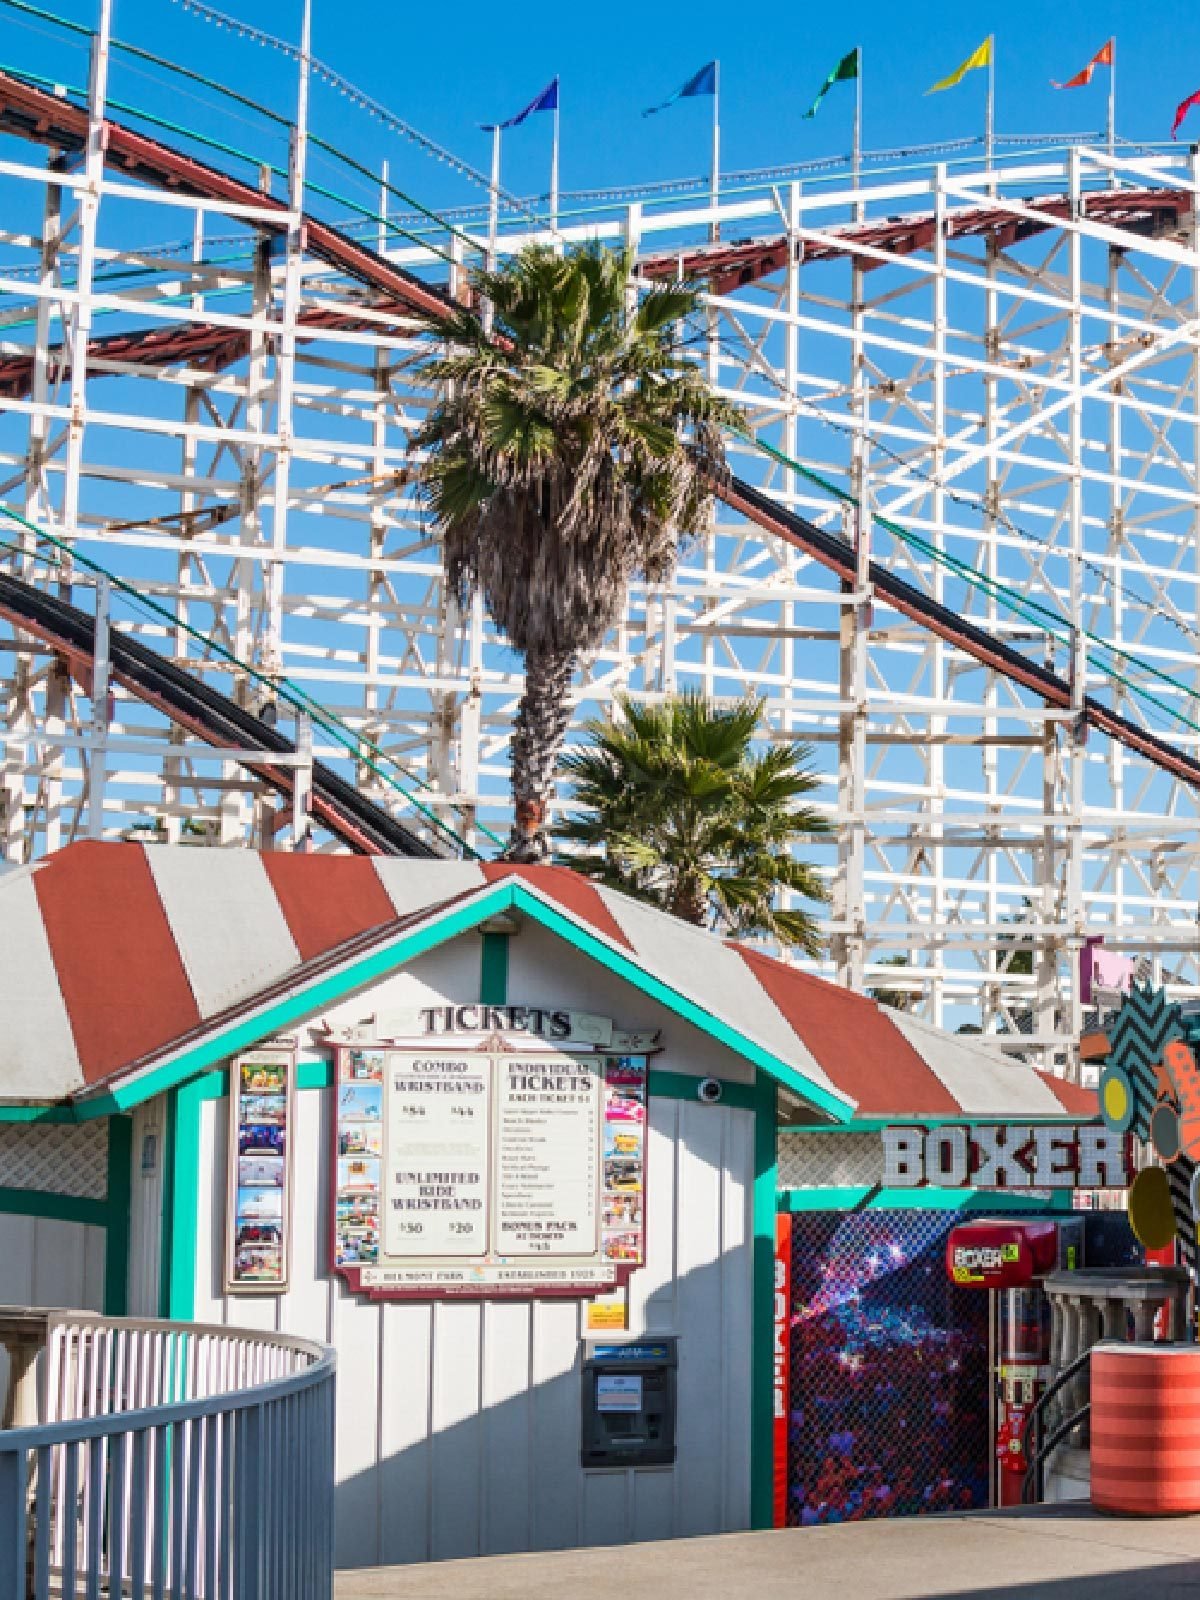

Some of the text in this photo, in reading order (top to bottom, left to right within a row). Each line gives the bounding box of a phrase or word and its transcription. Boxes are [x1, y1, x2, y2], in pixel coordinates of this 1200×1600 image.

[419, 1005, 572, 1041] TICKETS
[412, 1060, 468, 1072] COMBO
[394, 1081, 485, 1094] WRISTBAND
[507, 1075, 593, 1091] TICKETS
[881, 1126, 1131, 1188] BOXER
[395, 1172, 481, 1185] UNLIMITED
[419, 1185, 455, 1197] RIDE
[391, 1198, 483, 1211] WRISTBAND
[954, 1247, 1002, 1268] BOXER
